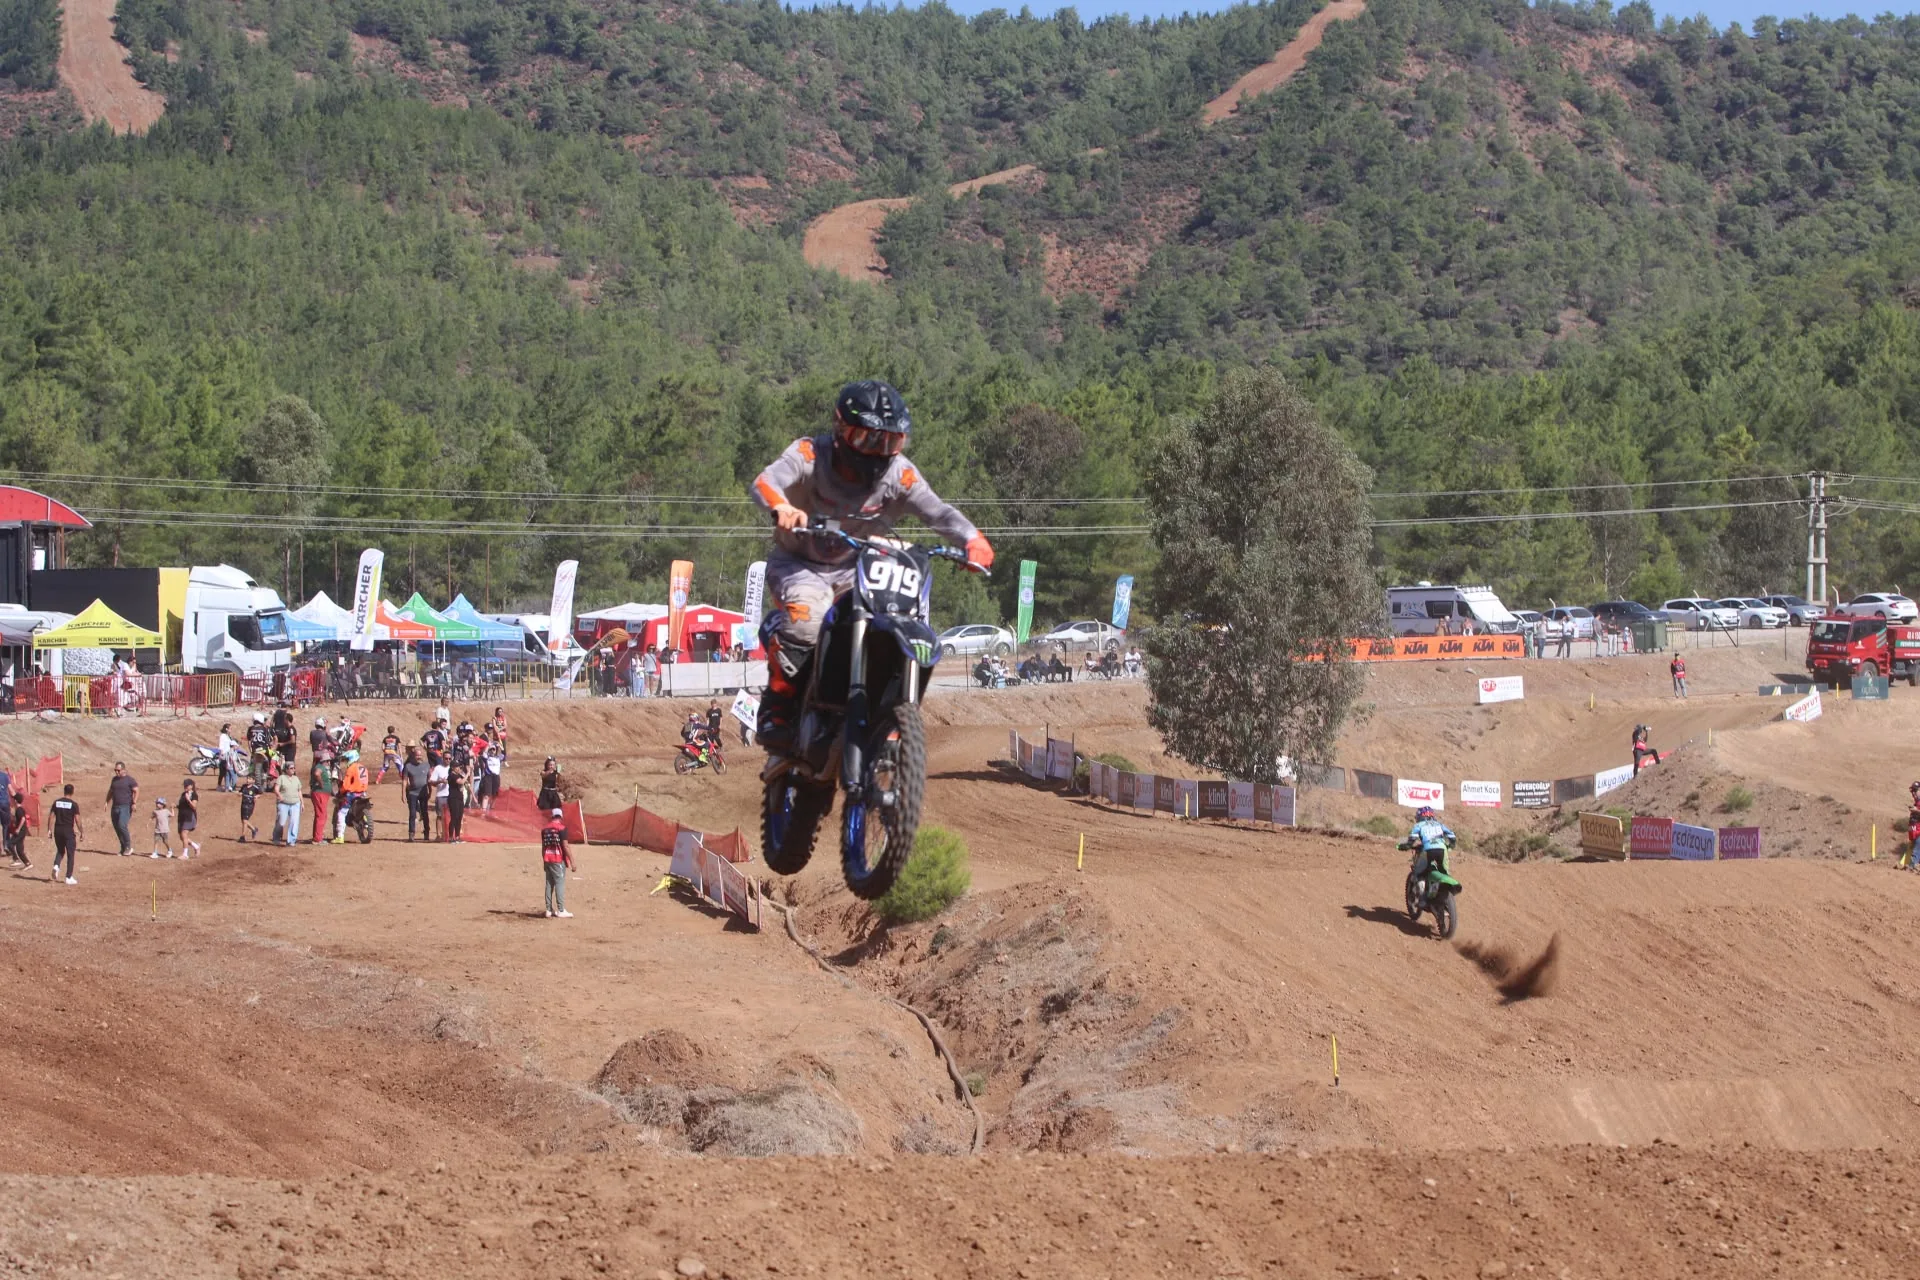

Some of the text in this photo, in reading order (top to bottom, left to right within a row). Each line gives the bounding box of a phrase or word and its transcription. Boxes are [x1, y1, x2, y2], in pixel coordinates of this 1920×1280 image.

[867, 561, 919, 598] 919
[745, 570, 757, 623] FETHİYE
[1404, 640, 1428, 655] KTM
[1438, 639, 1462, 654] KTM
[1473, 639, 1495, 652] KTM
[1503, 639, 1520, 653] KTM
[252, 732, 263, 742] 26
[1412, 789, 1430, 798] TMF
[1463, 783, 1500, 794] Ahmet Koca
